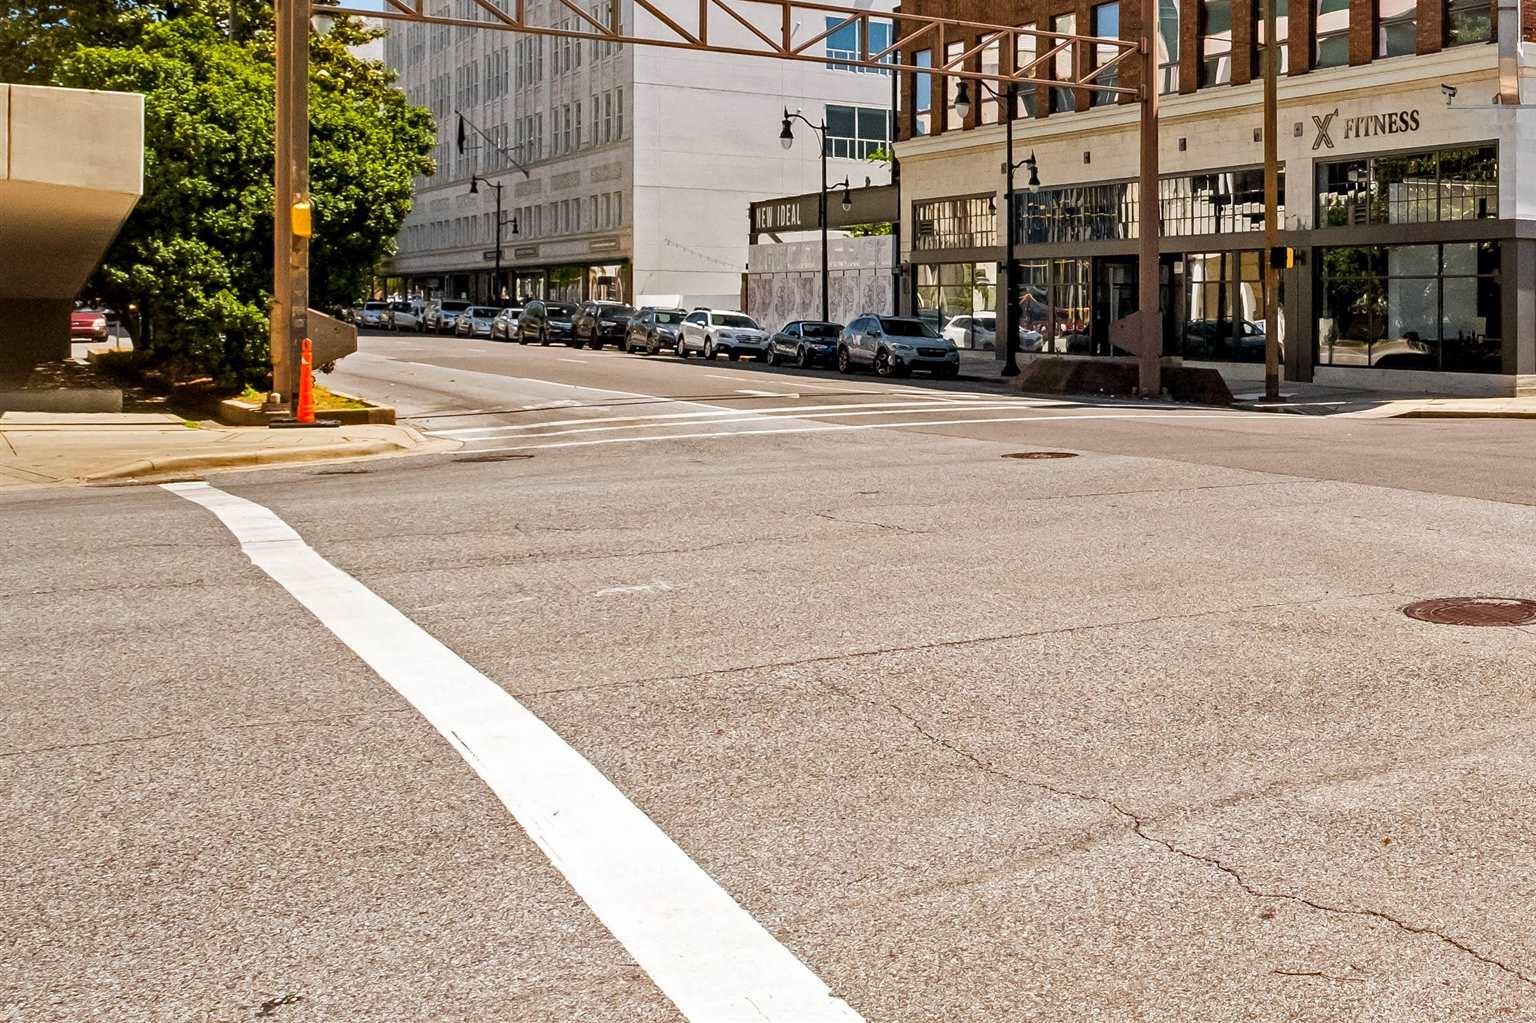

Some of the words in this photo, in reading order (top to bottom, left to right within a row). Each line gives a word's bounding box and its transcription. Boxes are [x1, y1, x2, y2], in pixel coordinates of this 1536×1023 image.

[1344, 109, 1420, 139] FITNESS
[756, 207, 773, 229] NEW
[777, 202, 801, 226] IDEAL
